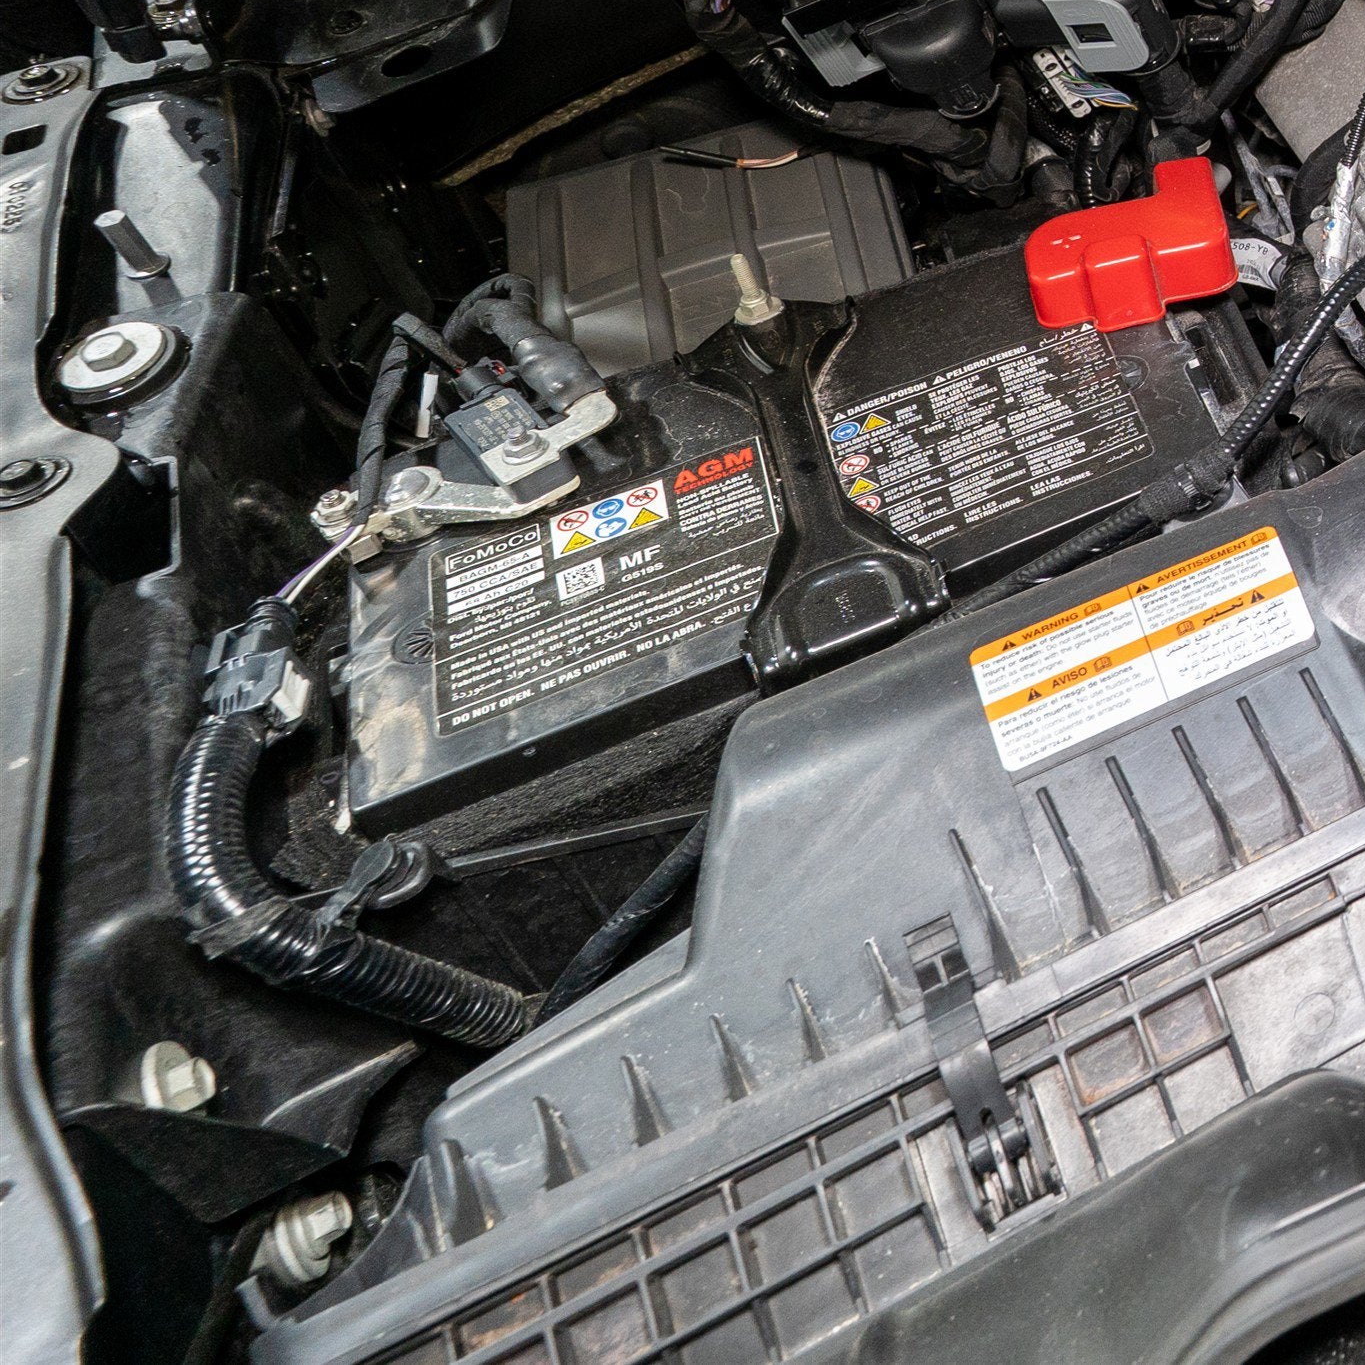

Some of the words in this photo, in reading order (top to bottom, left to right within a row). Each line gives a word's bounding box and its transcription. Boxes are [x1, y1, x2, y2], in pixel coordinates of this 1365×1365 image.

[945, 344, 1027, 379] PELIGRO/VENENO
[846, 380, 927, 416] DANGER/POISON
[671, 445, 754, 490] AGM
[674, 460, 753, 495] TECHNOLOGY
[1030, 481, 1044, 491] LEA
[1044, 474, 1061, 486] LAS
[1032, 467, 1093, 498] INSTRUCCIONES.
[676, 471, 749, 504] NON-SPILLABLE
[679, 508, 715, 528] CONTRA
[716, 491, 762, 515] DERRAMES
[963, 506, 982, 519] LIRE
[982, 500, 997, 510] LES
[965, 495, 1023, 524] INSTRUCTIONS.
[449, 527, 537, 570] FoMoCo
[619, 542, 662, 571] MF
[1155, 540, 1248, 583] AVERTISSEMENT
[453, 584, 475, 599] 750
[479, 561, 538, 589] CCA/SAE
[459, 551, 530, 583] BAGM-65-A
[1139, 590, 1158, 601] Pour
[1159, 577, 1186, 593] réduire
[1196, 563, 1221, 577] risque
[1222, 558, 1231, 566] de
[1233, 542, 1269, 561] blessures
[1141, 593, 1167, 609] graves
[1169, 588, 1180, 596] ou
[1181, 583, 1191, 591] de
[450, 654, 476, 670] Made
[478, 650, 486, 659] in
[488, 641, 508, 655] USA
[510, 633, 530, 646] with
[532, 627, 544, 638] US
[546, 620, 563, 632] and
[564, 604, 604, 627] imported
[605, 586, 650, 610] materials.
[980, 661, 992, 670] To
[991, 649, 1020, 665] reduce
[1021, 641, 1037, 652] risk
[1039, 637, 1048, 645] of
[1048, 622, 1083, 642] possible
[1084, 609, 1114, 626] serious
[1021, 611, 1079, 641] WARNING
[982, 664, 1006, 679] injury
[1007, 659, 1016, 667] or
[1045, 642, 1056, 651] Do
[1058, 635, 1072, 645] not
[1072, 630, 1086, 639] use
[1087, 619, 1111, 633] starter
[1112, 610, 1132, 622] fluids
[452, 712, 468, 726] DO
[470, 701, 496, 719] NOT
[499, 686, 535, 708] OPEN.
[540, 677, 557, 691] NE
[559, 667, 581, 684] PAS
[583, 648, 630, 674] OUVRIR.
[636, 639, 653, 653] NO
[654, 632, 671, 645] LA
[672, 618, 705, 638] ABRA.
[1050, 666, 1088, 689] AVISO
[997, 714, 1017, 728] Para
[1018, 701, 1048, 719] reducir
[1049, 696, 1059, 705] el
[1059, 685, 1086, 702] riesgo
[1087, 679, 1097, 688] de
[1099, 664, 1133, 683] lesiones
[1000, 719, 1033, 737] severas
